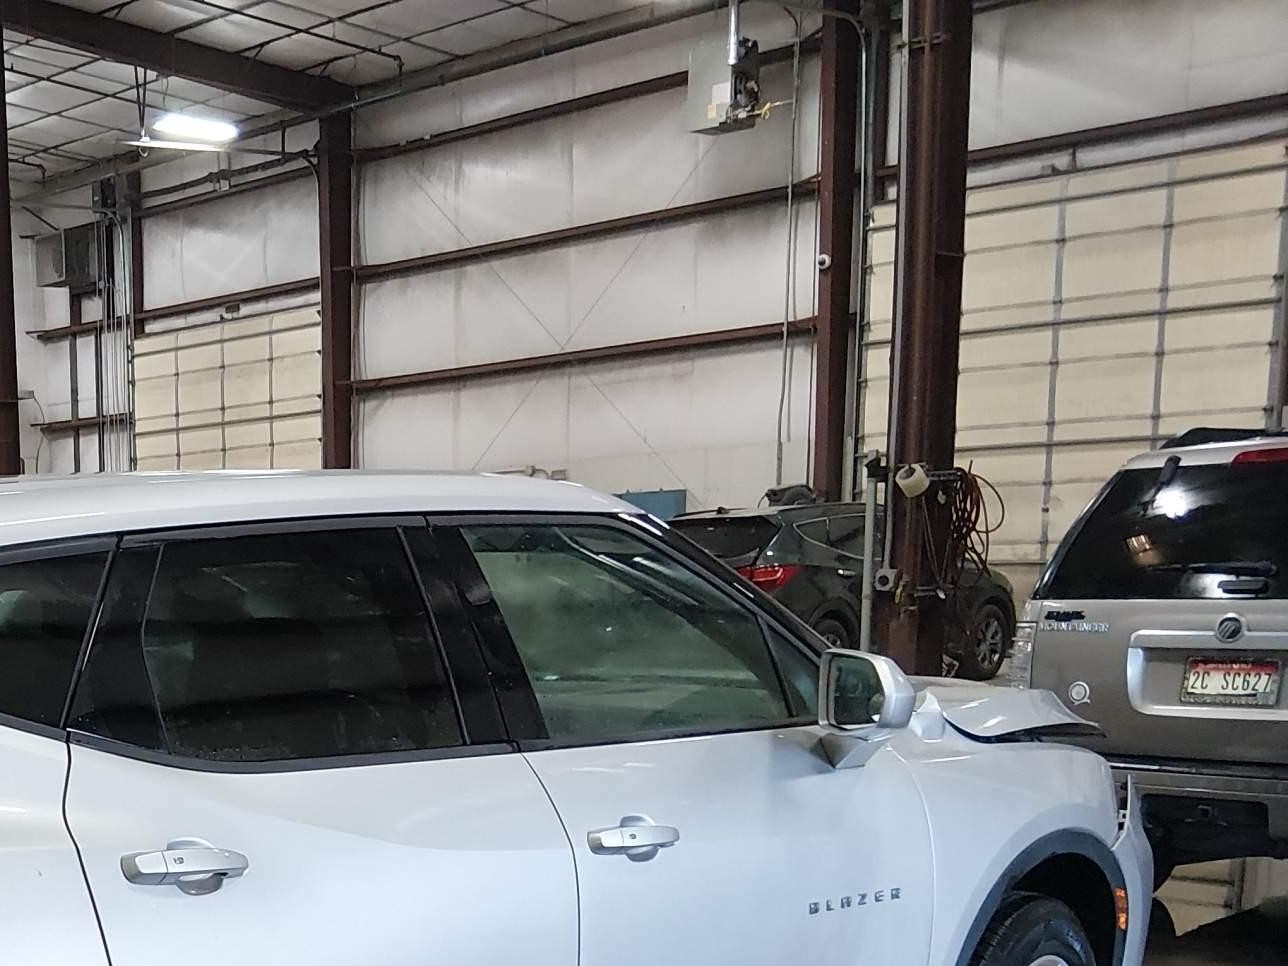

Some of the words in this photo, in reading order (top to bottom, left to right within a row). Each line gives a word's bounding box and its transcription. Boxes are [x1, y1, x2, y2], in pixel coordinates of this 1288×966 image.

[1190, 670, 1210, 690] 2C
[1221, 671, 1272, 693] SC627
[808, 887, 902, 915] BLAZER
